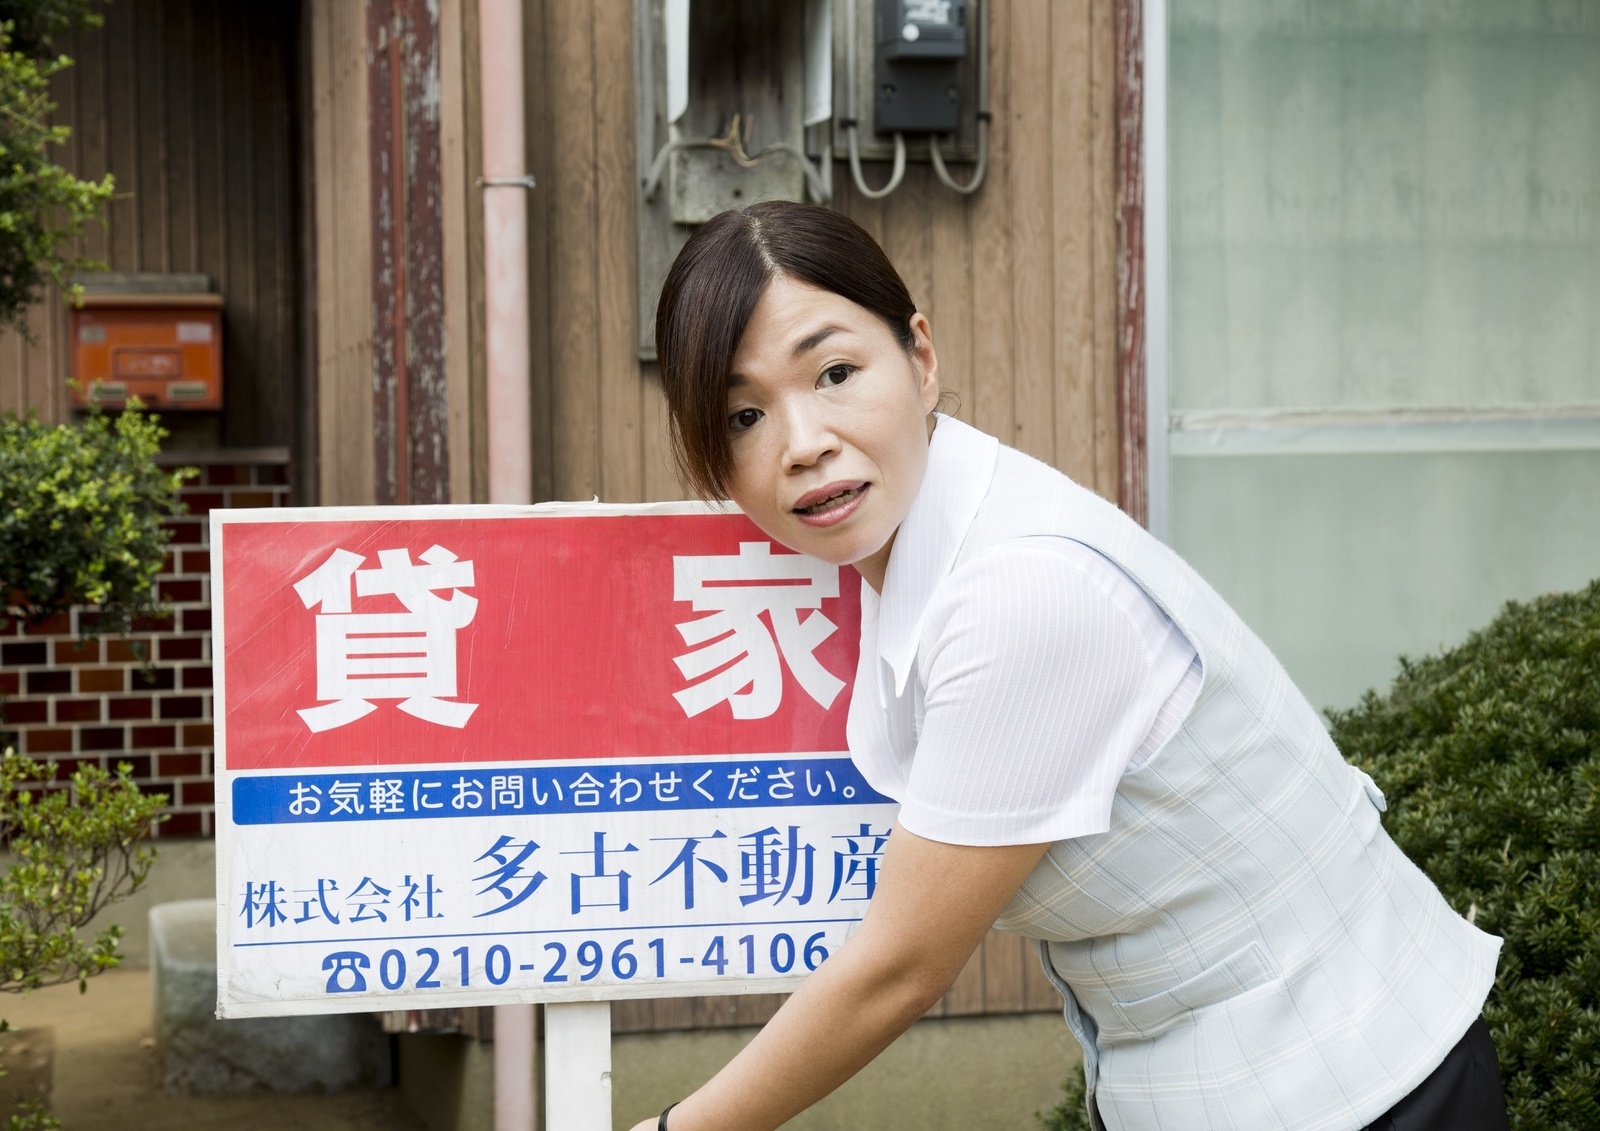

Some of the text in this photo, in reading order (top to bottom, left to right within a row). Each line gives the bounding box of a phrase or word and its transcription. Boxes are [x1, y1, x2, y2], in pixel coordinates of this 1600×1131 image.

[288, 767, 856, 816] お気軽にお問い合わせください。
[239, 874, 445, 929] 株式会社
[380, 931, 829, 991] 0210-2961-4106
